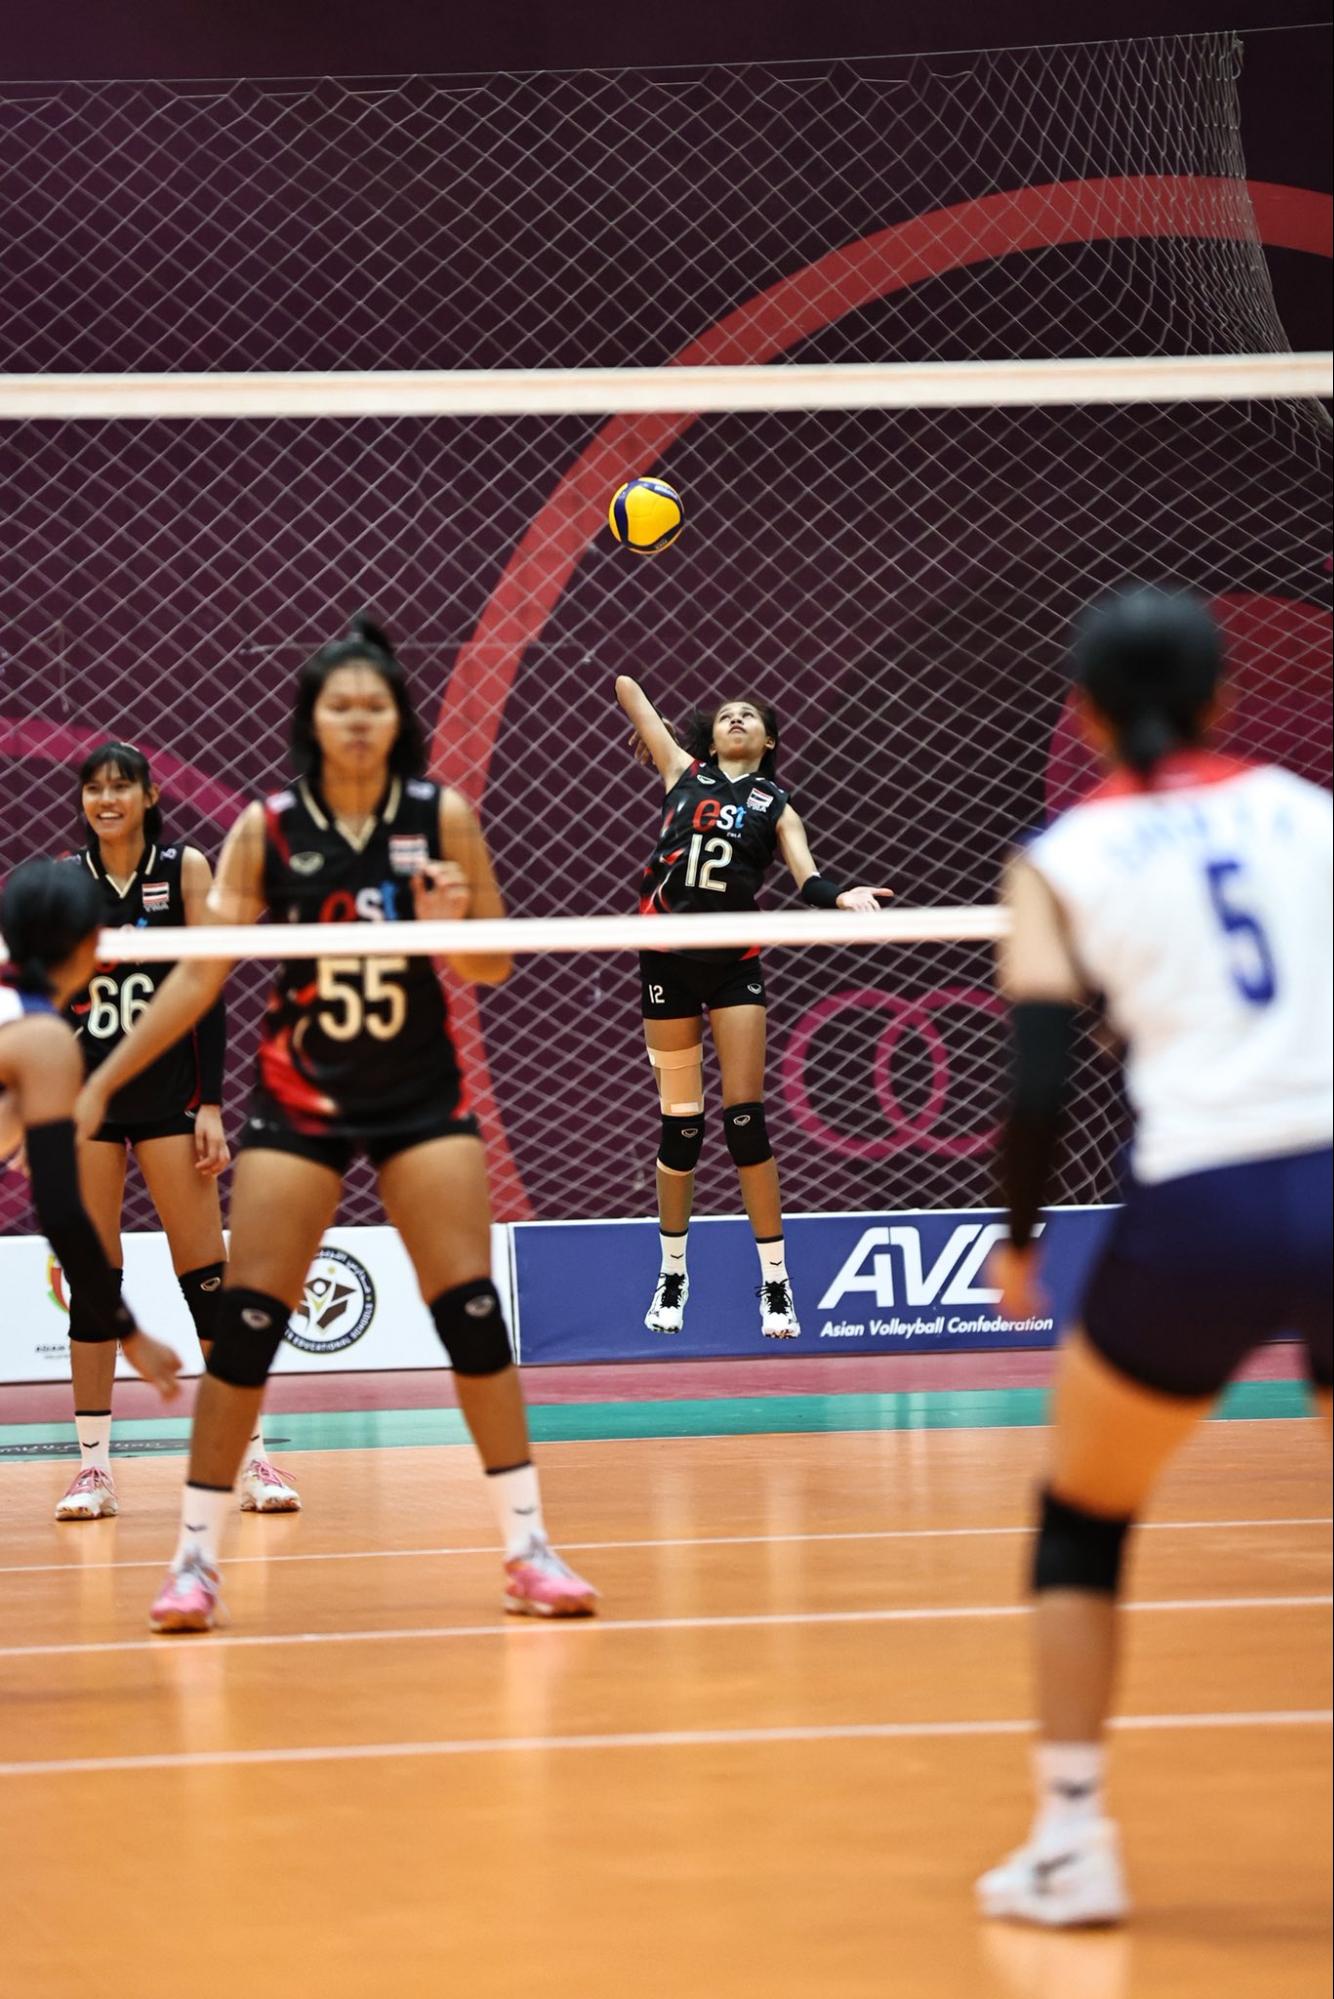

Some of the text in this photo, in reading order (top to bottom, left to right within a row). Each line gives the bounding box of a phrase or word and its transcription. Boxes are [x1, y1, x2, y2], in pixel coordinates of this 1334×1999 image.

[692, 799, 747, 832] est
[685, 834, 733, 892] 12
[1205, 858, 1277, 1006] 5
[88, 972, 154, 1039] 66
[317, 957, 408, 1041] 55
[648, 984, 665, 1004] 12
[819, 1315, 1054, 1340] Asian Volleyball Confederation
